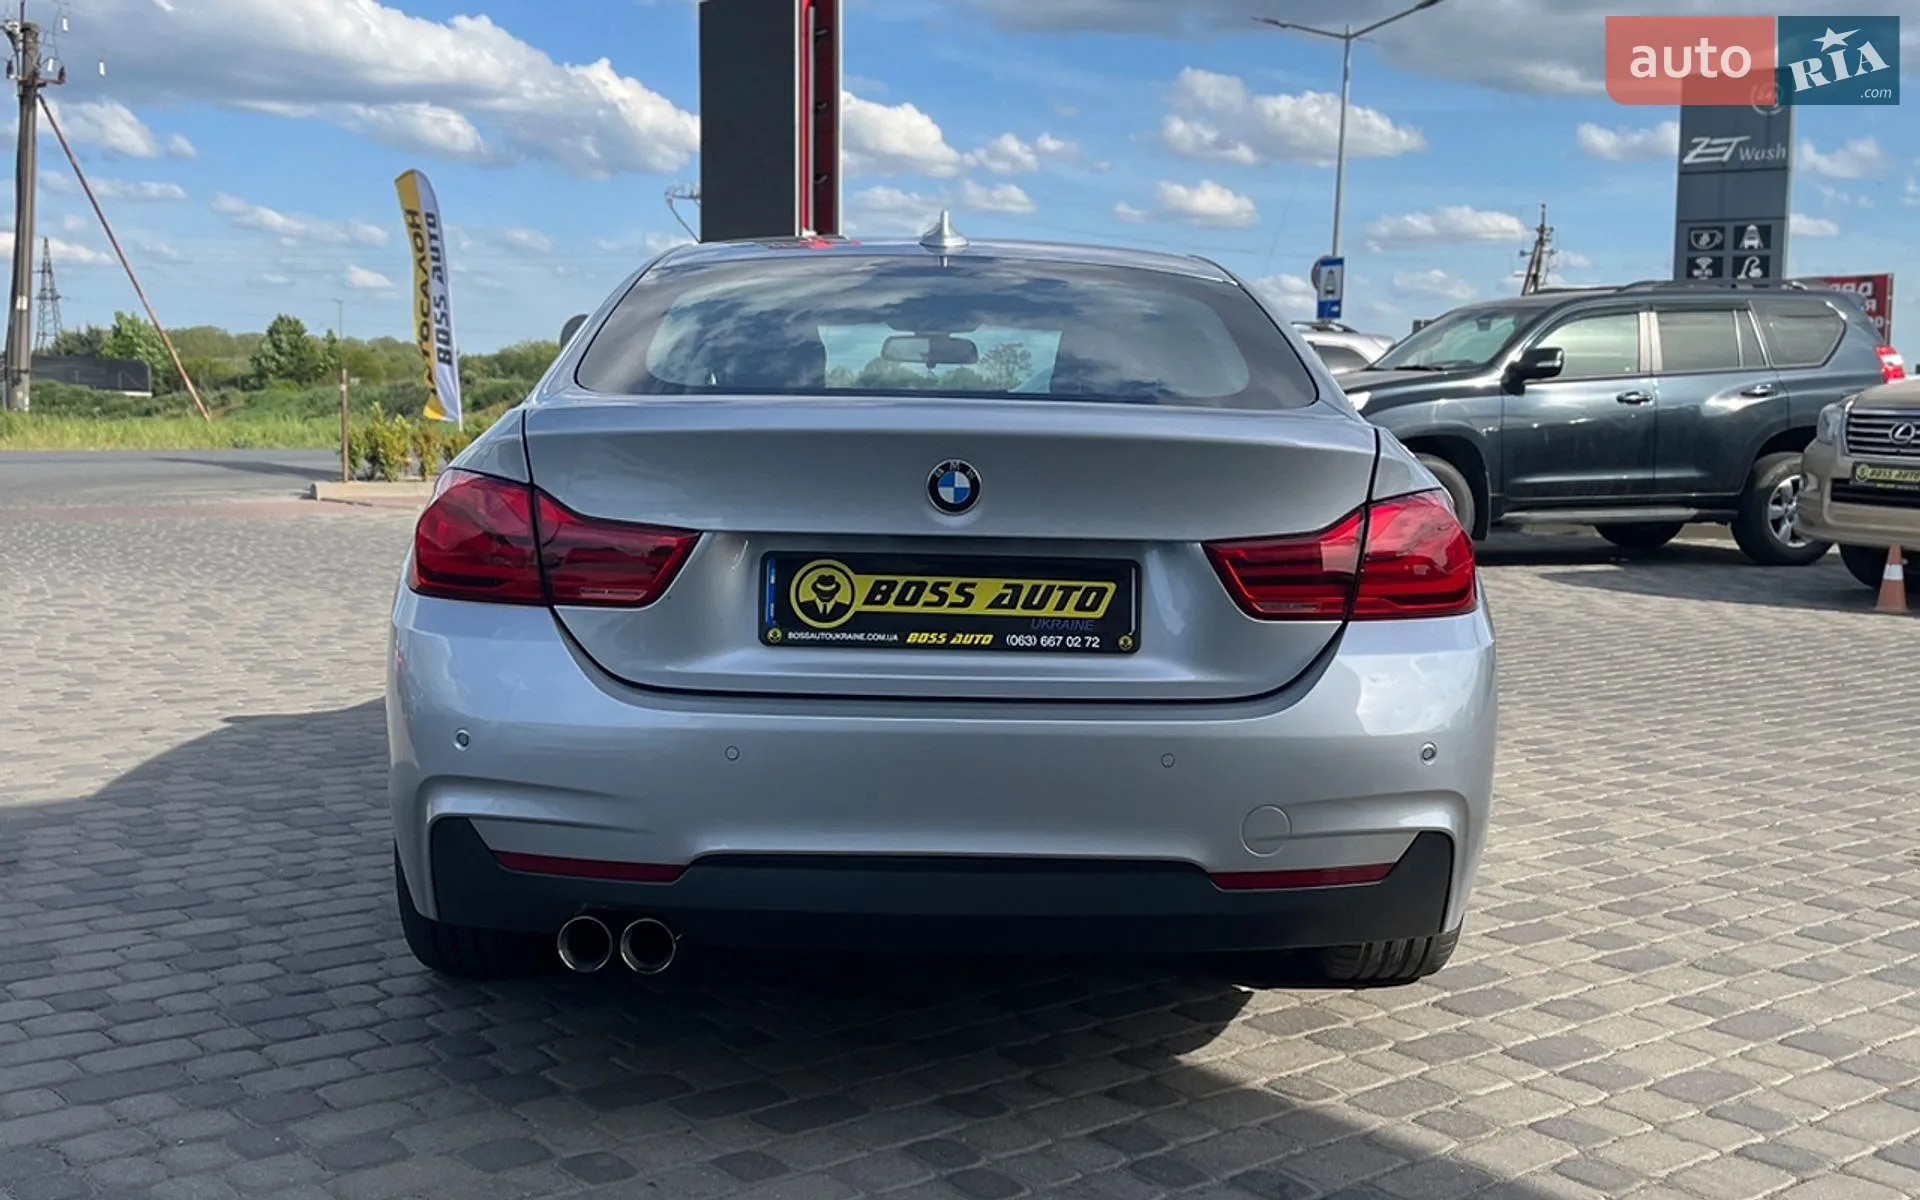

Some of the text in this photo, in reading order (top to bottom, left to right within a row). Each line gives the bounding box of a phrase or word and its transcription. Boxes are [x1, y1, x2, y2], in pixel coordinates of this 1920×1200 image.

[1738, 142, 1787, 162] Wash
[424, 211, 453, 366] BOSS AUTO
[861, 579, 1111, 613] BOSS AUTO
[1031, 619, 1096, 631] UKRAINE
[787, 631, 899, 642] BOSSAUTOUKRAINE.COM.UA
[905, 632, 994, 646] BOSS AUTO
[1006, 634, 1100, 649] (063) 667 02 72
